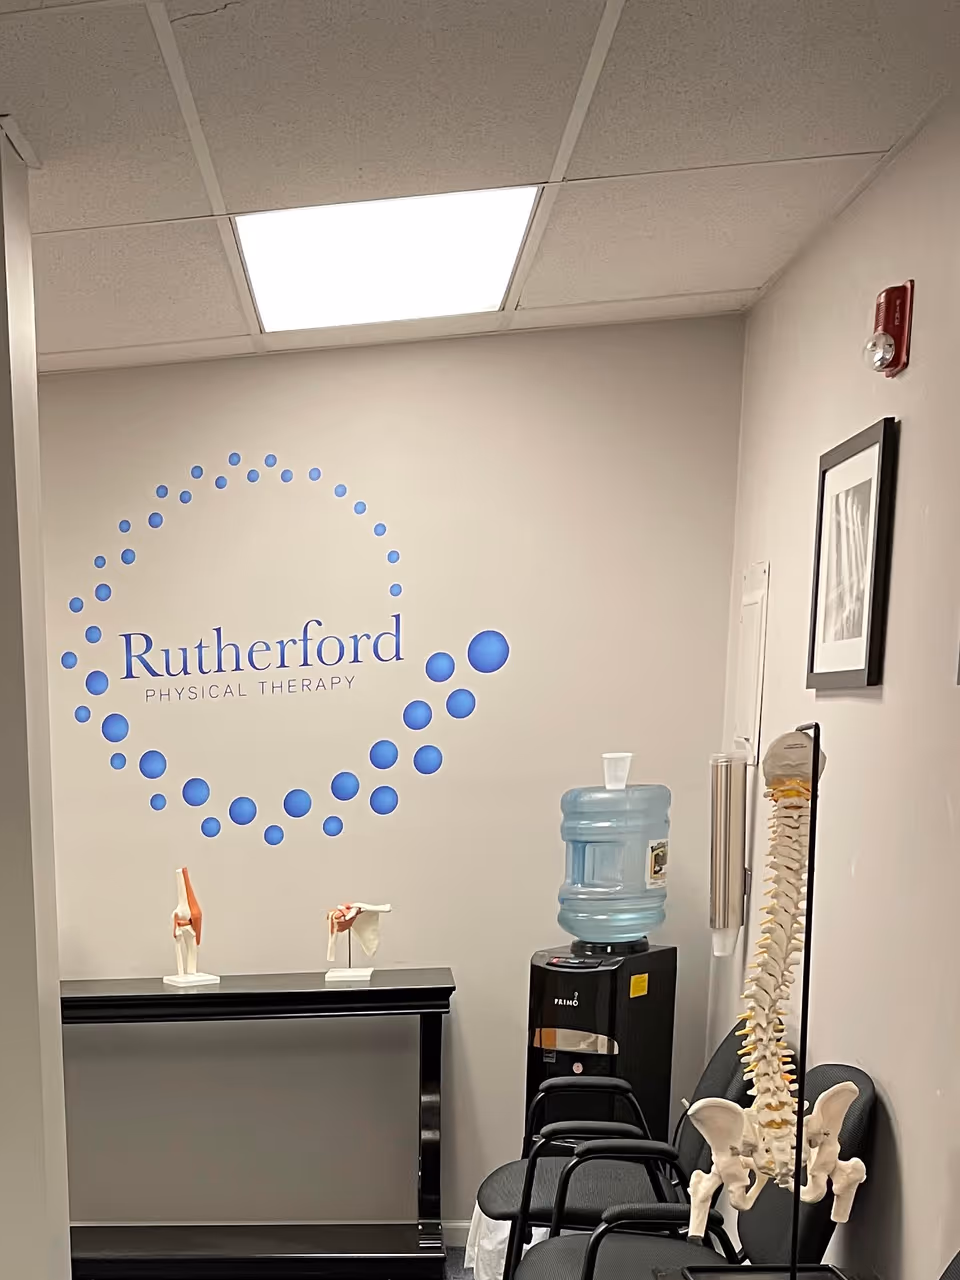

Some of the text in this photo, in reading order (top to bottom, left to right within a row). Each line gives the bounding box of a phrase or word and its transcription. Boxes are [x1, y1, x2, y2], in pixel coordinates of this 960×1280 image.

[119, 613, 404, 680] Rutherford
[145, 675, 356, 703] PHYSICAL THERAPY
[554, 998, 579, 1006] PRIMO
